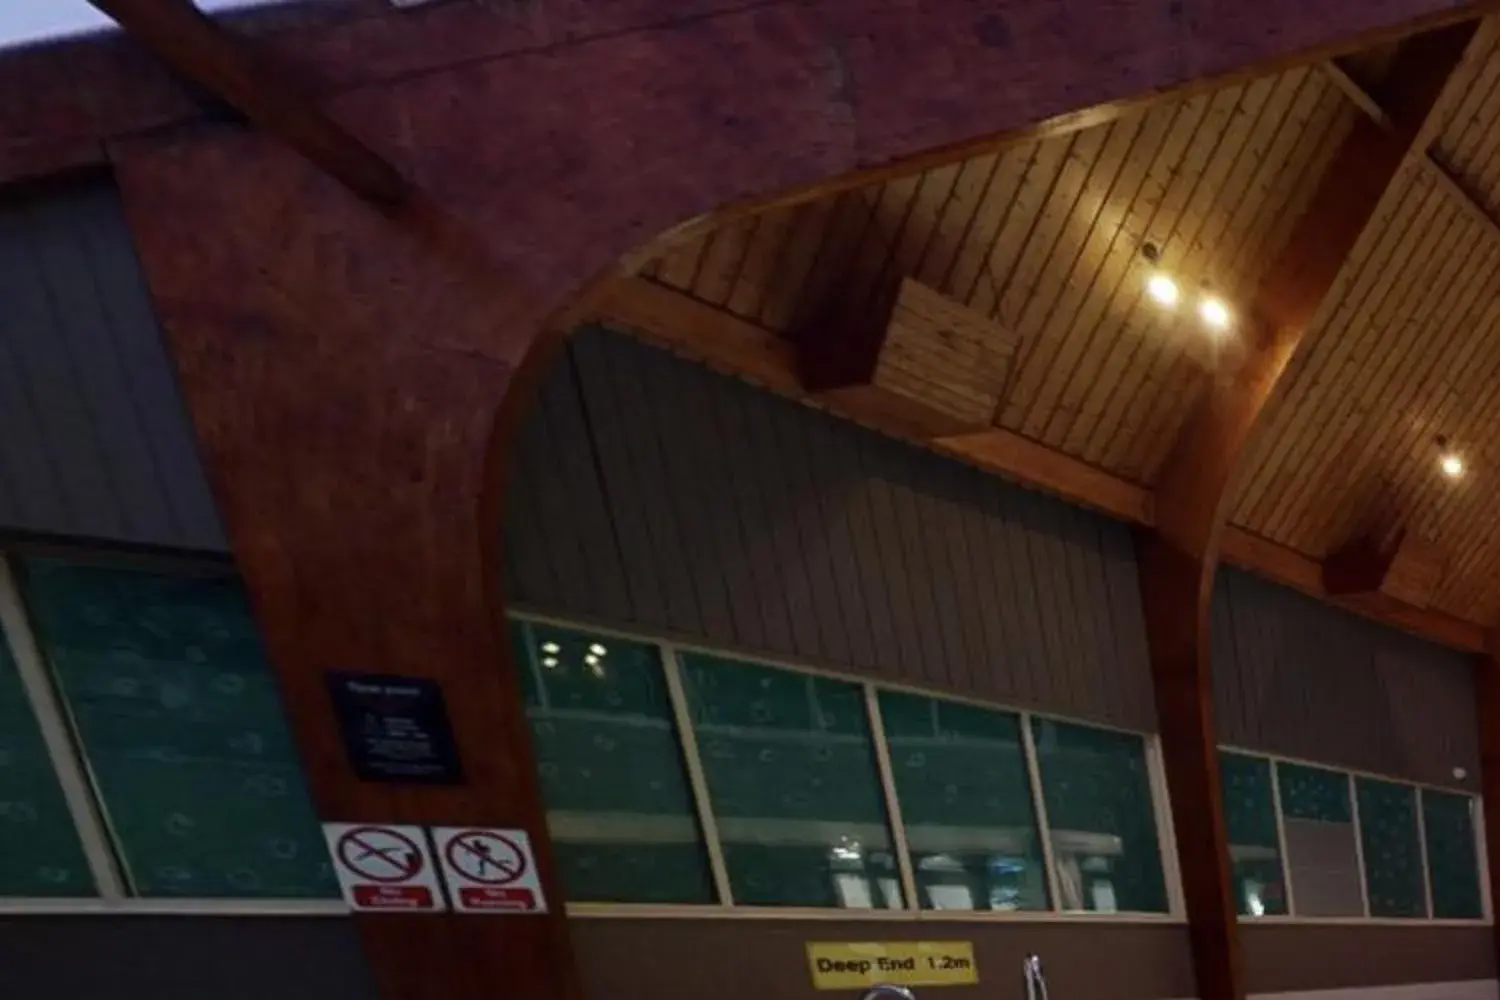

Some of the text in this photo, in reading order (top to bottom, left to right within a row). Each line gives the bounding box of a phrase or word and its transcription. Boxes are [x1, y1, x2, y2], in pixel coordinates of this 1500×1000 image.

[817, 956, 970, 975] Deep End 1.2m
